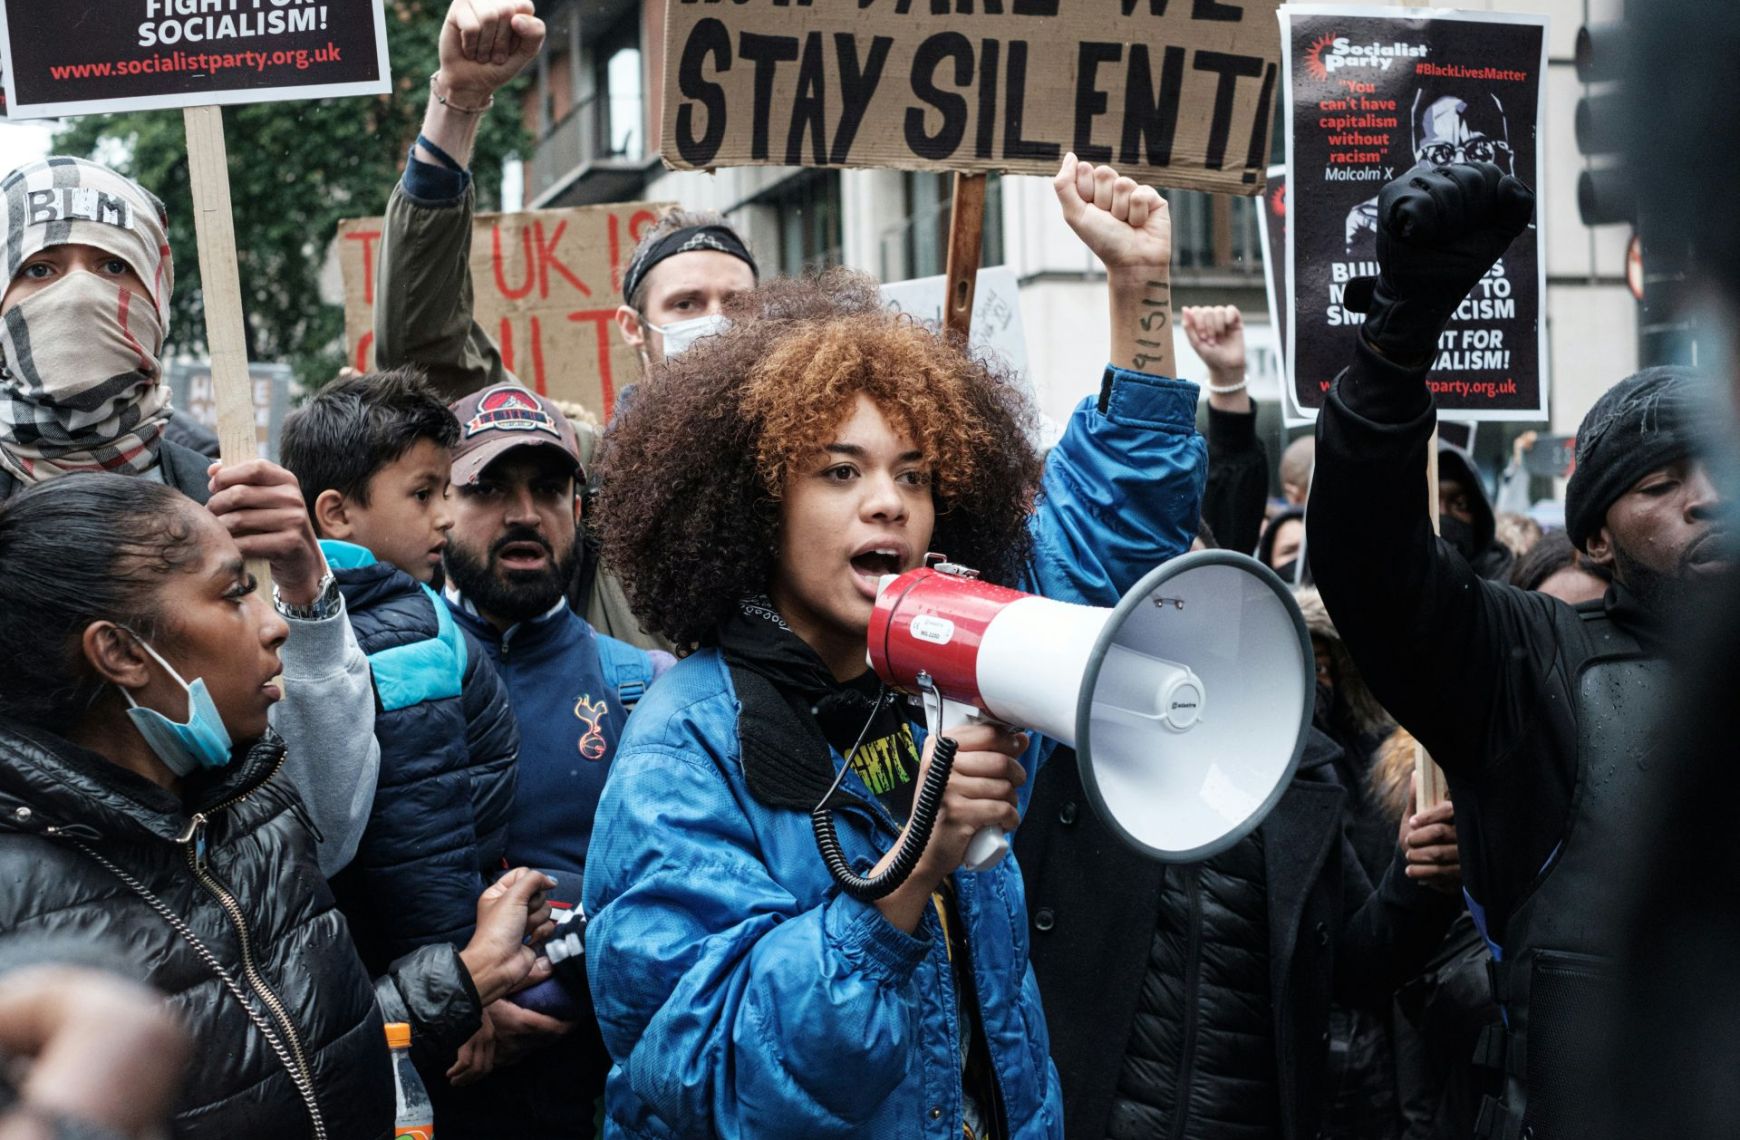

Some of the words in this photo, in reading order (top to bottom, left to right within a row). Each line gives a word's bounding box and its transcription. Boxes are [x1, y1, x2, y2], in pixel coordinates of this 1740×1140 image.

[138, 6, 328, 47] SOCIALISM!
[1332, 37, 1428, 57] Socialist
[50, 42, 342, 80] www.socialistparty.org.uk
[1416, 63, 1527, 81] #BlackLivesMatter
[675, 17, 894, 166] STAY
[904, 31, 1277, 184] SILENT!
[1320, 97, 1358, 110] can't
[1361, 96, 1396, 110] have
[1319, 113, 1397, 131] capitalism
[1328, 131, 1389, 145] without
[1330, 150, 1388, 163] racism"
[1325, 166, 1381, 181] Malcolm
[1383, 167, 1394, 180] X
[27, 188, 126, 226] BLM
[493, 220, 591, 299] UK
[1479, 278, 1511, 297] TO
[1451, 299, 1515, 320] CISM
[1462, 330, 1503, 349] FOR
[1431, 350, 1510, 370] ALISM!
